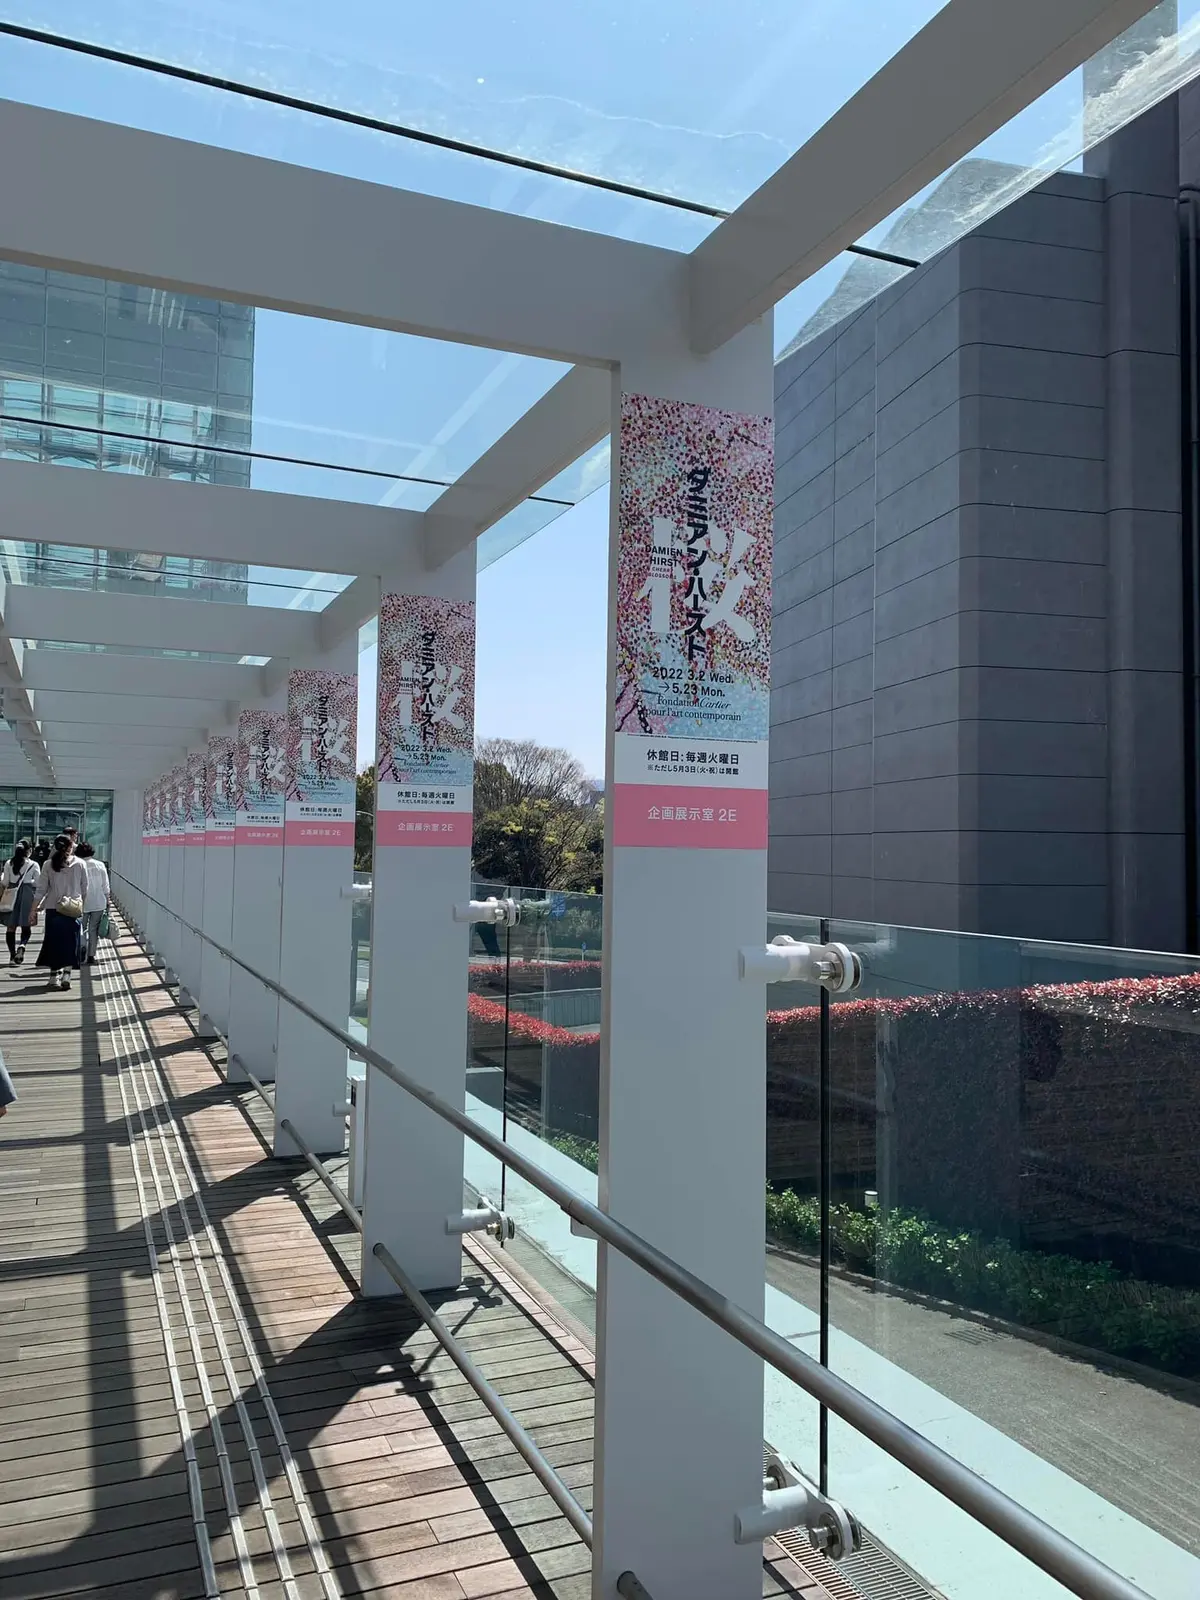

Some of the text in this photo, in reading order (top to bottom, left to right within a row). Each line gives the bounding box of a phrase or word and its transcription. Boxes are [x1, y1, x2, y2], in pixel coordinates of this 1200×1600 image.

[645, 544, 683, 557] DAMIEN
[650, 556, 678, 567] HIRST
[684, 466, 711, 661] ダミアン・ハースト
[652, 666, 734, 684] 2022 3.2 Wed.
[420, 631, 437, 741] ダミアン・ハースト
[672, 682, 726, 697] 5.23 Mon.
[646, 708, 667, 717] pour
[684, 711, 742, 722] contemporain
[317, 695, 329, 772] ダミアン・ハースト
[401, 744, 420, 752] 2022
[430, 753, 447, 761] Mon.
[648, 805, 737, 822] 企画展示室 2E
[441, 823, 454, 832] 2E
